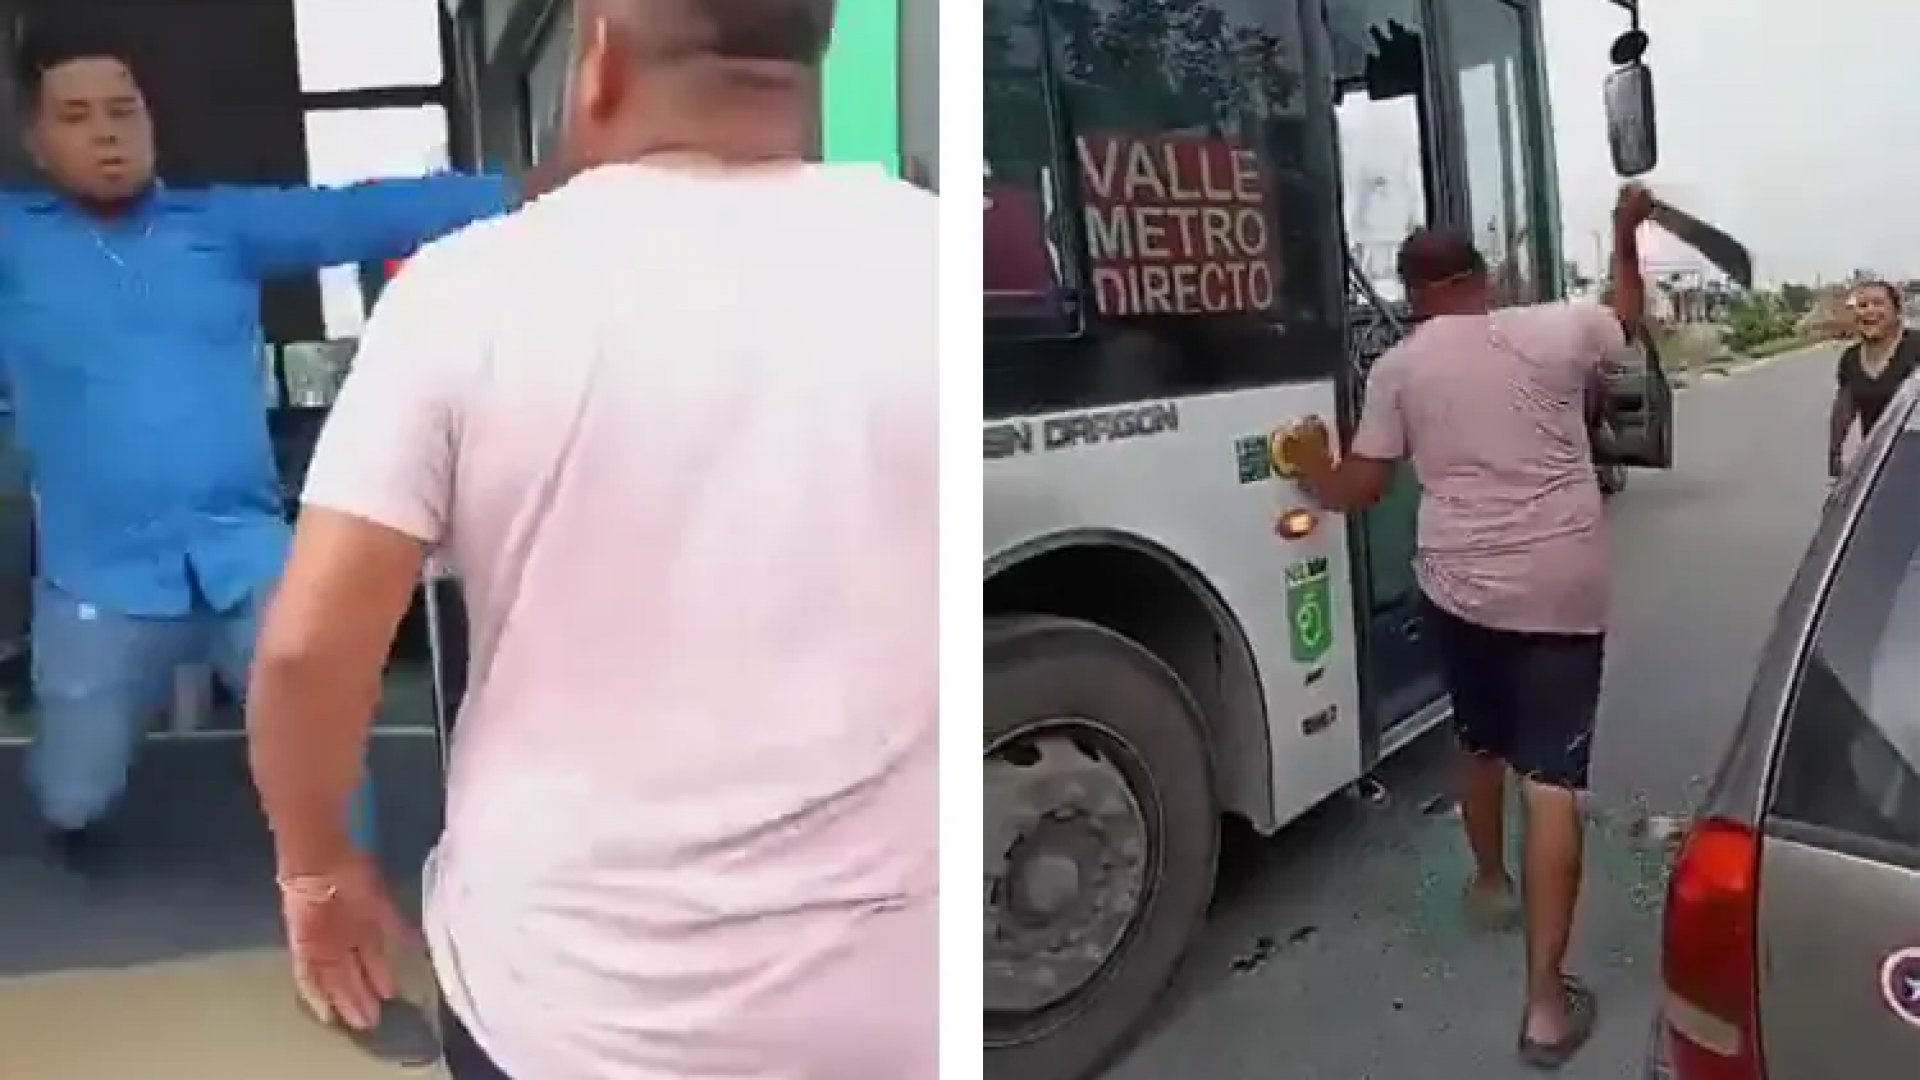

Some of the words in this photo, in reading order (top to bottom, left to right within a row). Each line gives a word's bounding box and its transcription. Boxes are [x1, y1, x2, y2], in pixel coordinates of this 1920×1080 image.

[1075, 135, 1262, 201] VALLE
[1084, 204, 1268, 258] METRO
[1093, 261, 1273, 315] DIRECTO
[1044, 401, 1178, 450] DRAGON
